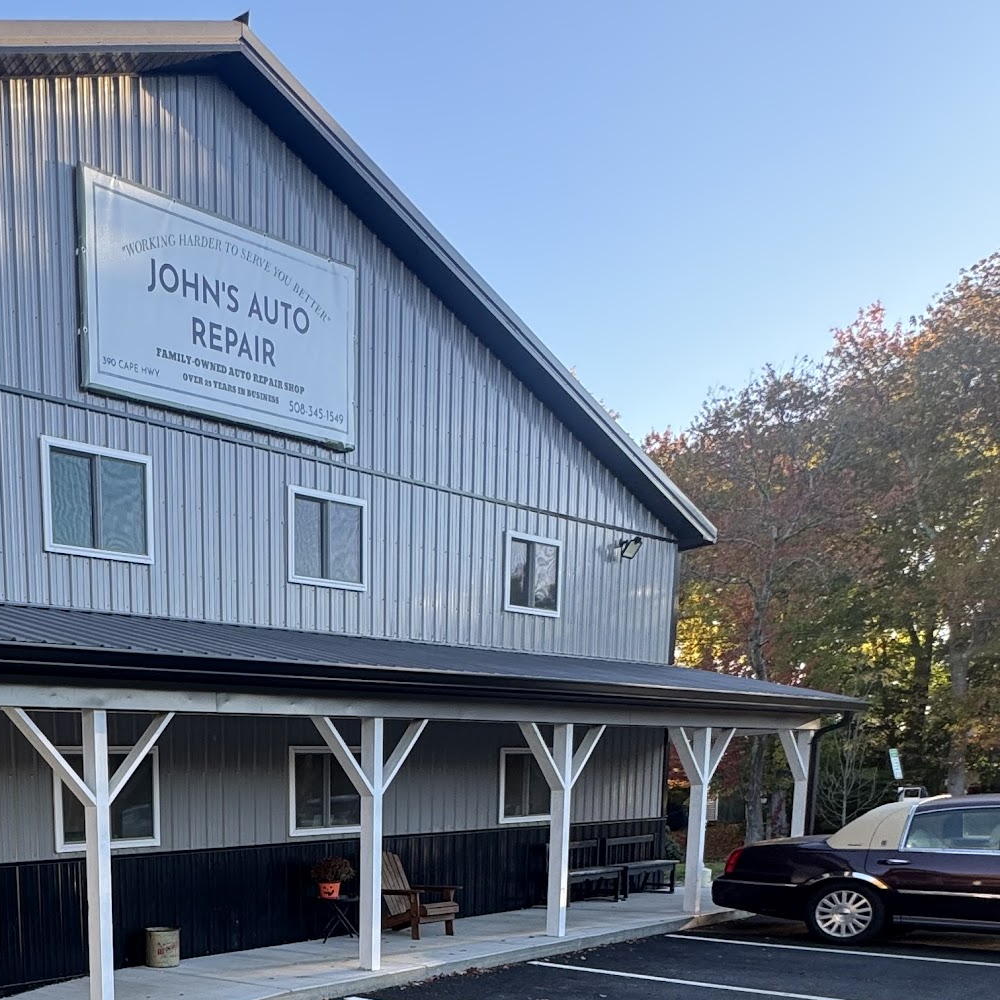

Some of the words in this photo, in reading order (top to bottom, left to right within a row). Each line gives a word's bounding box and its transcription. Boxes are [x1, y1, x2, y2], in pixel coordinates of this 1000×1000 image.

[179, 234, 222, 252] HARDER
[224, 241, 239, 256] TO
[240, 249, 271, 273] SERVE
[273, 266, 293, 287] YOU
[147, 258, 240, 313] JOHN'S
[247, 291, 310, 335] AUTO
[192, 316, 276, 368] REPAIR
[102, 356, 117, 368] 390
[118, 359, 139, 374] CAPE
[141, 366, 160, 378] HWY
[156, 347, 228, 374] FAMILY-OWNED
[228, 366, 252, 382] AUTO
[253, 373, 283, 390] REPAIR
[283, 382, 305, 395] SHOP
[182, 372, 204, 386] OVER
[213, 380, 237, 394] YEARS
[237, 386, 246, 396] IN
[246, 388, 280, 405] BUSINESS
[288, 400, 344, 425] 508-345-1549
